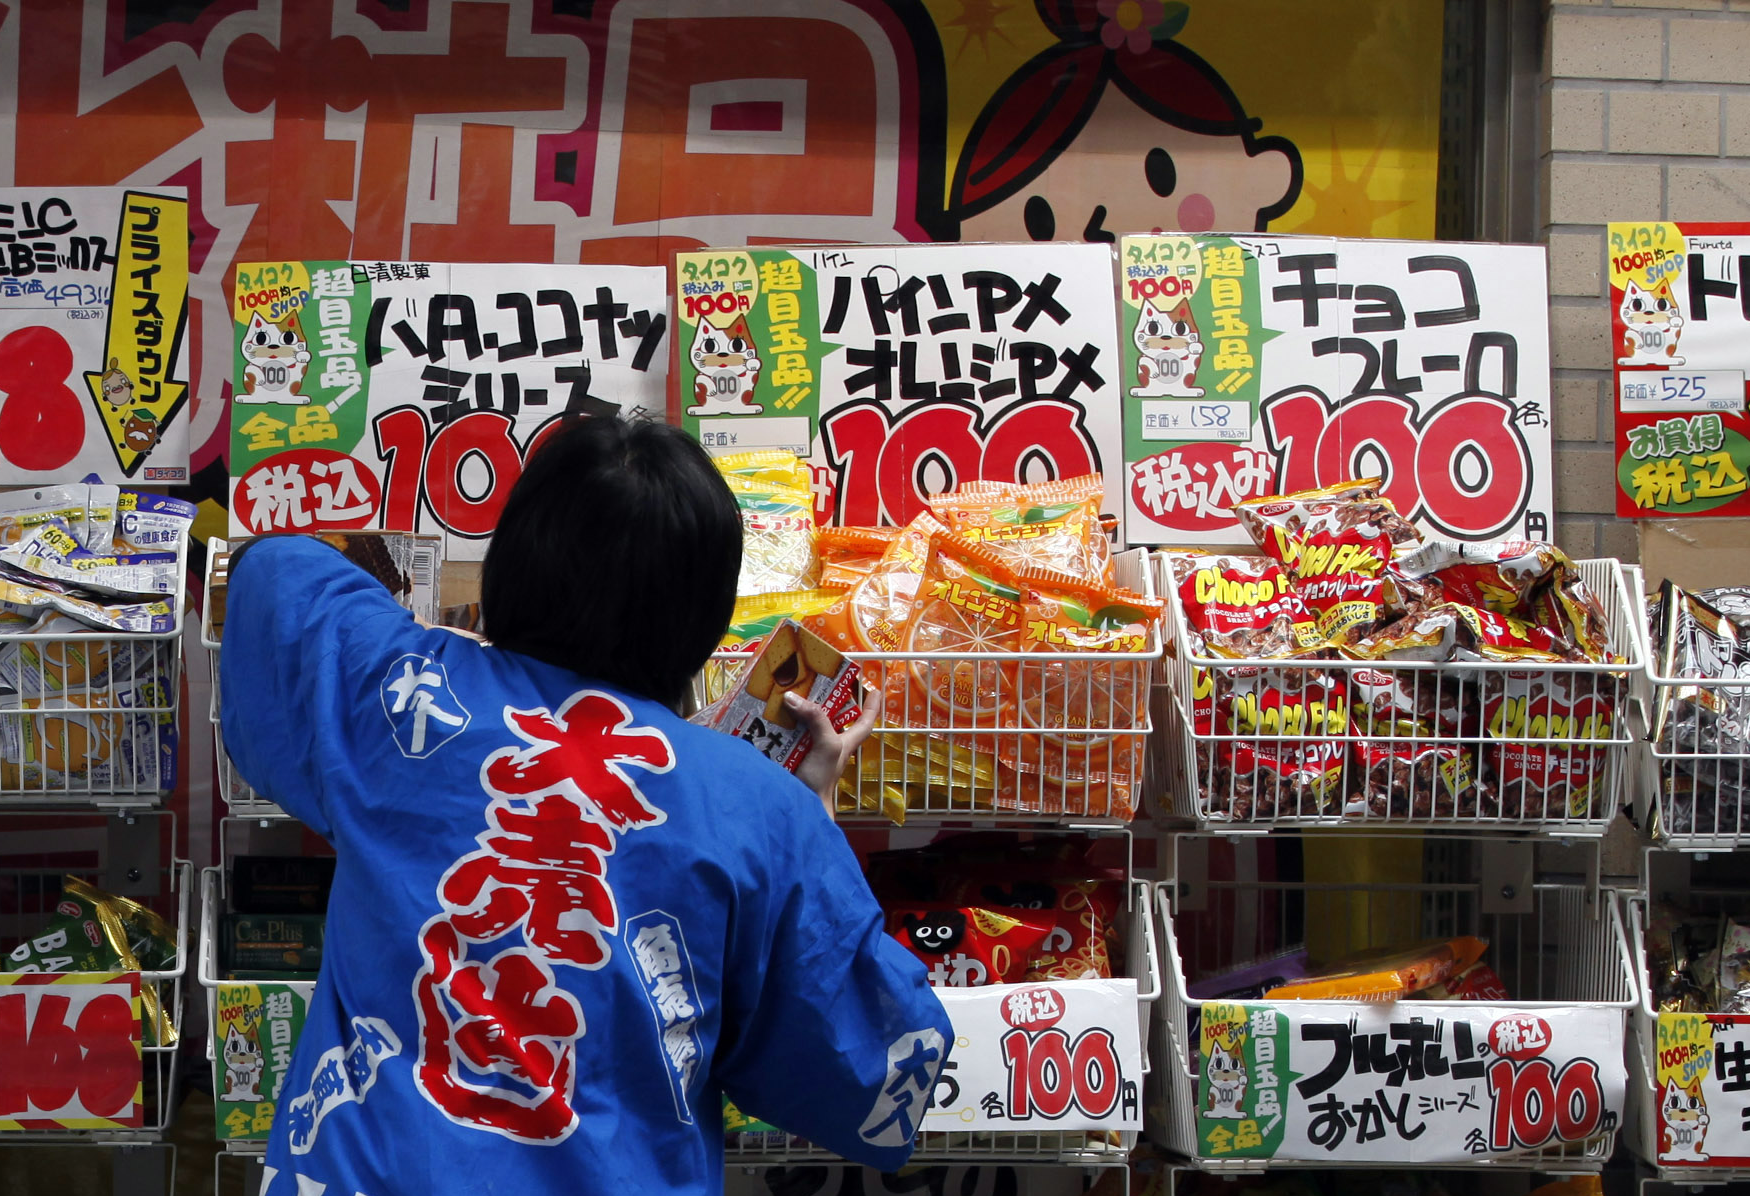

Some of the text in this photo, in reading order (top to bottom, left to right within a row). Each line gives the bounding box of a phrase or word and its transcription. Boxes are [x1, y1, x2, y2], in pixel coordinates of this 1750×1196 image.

[1126, 241, 1196, 264] ダイコク
[1688, 238, 1733, 252] Furuta
[238, 264, 294, 290] ダイコク
[352, 263, 431, 284] 日清製菓
[682, 256, 748, 278] ダイコク
[1645, 254, 1686, 282] SHOP
[129, 206, 162, 403] プライスダウン
[270, 290, 310, 318] SHOP
[682, 282, 724, 295] 税込み
[1129, 276, 1194, 301] 100円
[1273, 254, 1480, 328] チョコ
[683, 295, 750, 318] 100円
[1313, 331, 1518, 394] フレーク
[239, 406, 339, 451] 全品
[1626, 414, 1723, 460] お買得
[819, 395, 1104, 529] 100
[1259, 385, 1533, 541] 100
[246, 458, 373, 532] 税込
[1135, 445, 1271, 520] 税込み
[1631, 452, 1748, 509] 税込
[962, 522, 1084, 543] オレンジアメ
[1526, 510, 1547, 540] 円
[1008, 994, 1059, 1025] 税込
[1495, 1020, 1547, 1054] 税込
[1001, 1028, 1121, 1121] 100
[1122, 1078, 1137, 1121] 円
[1488, 1056, 1606, 1153] 100
[1205, 1120, 1262, 1154] 全品
[1308, 1090, 1427, 1152] おかし
